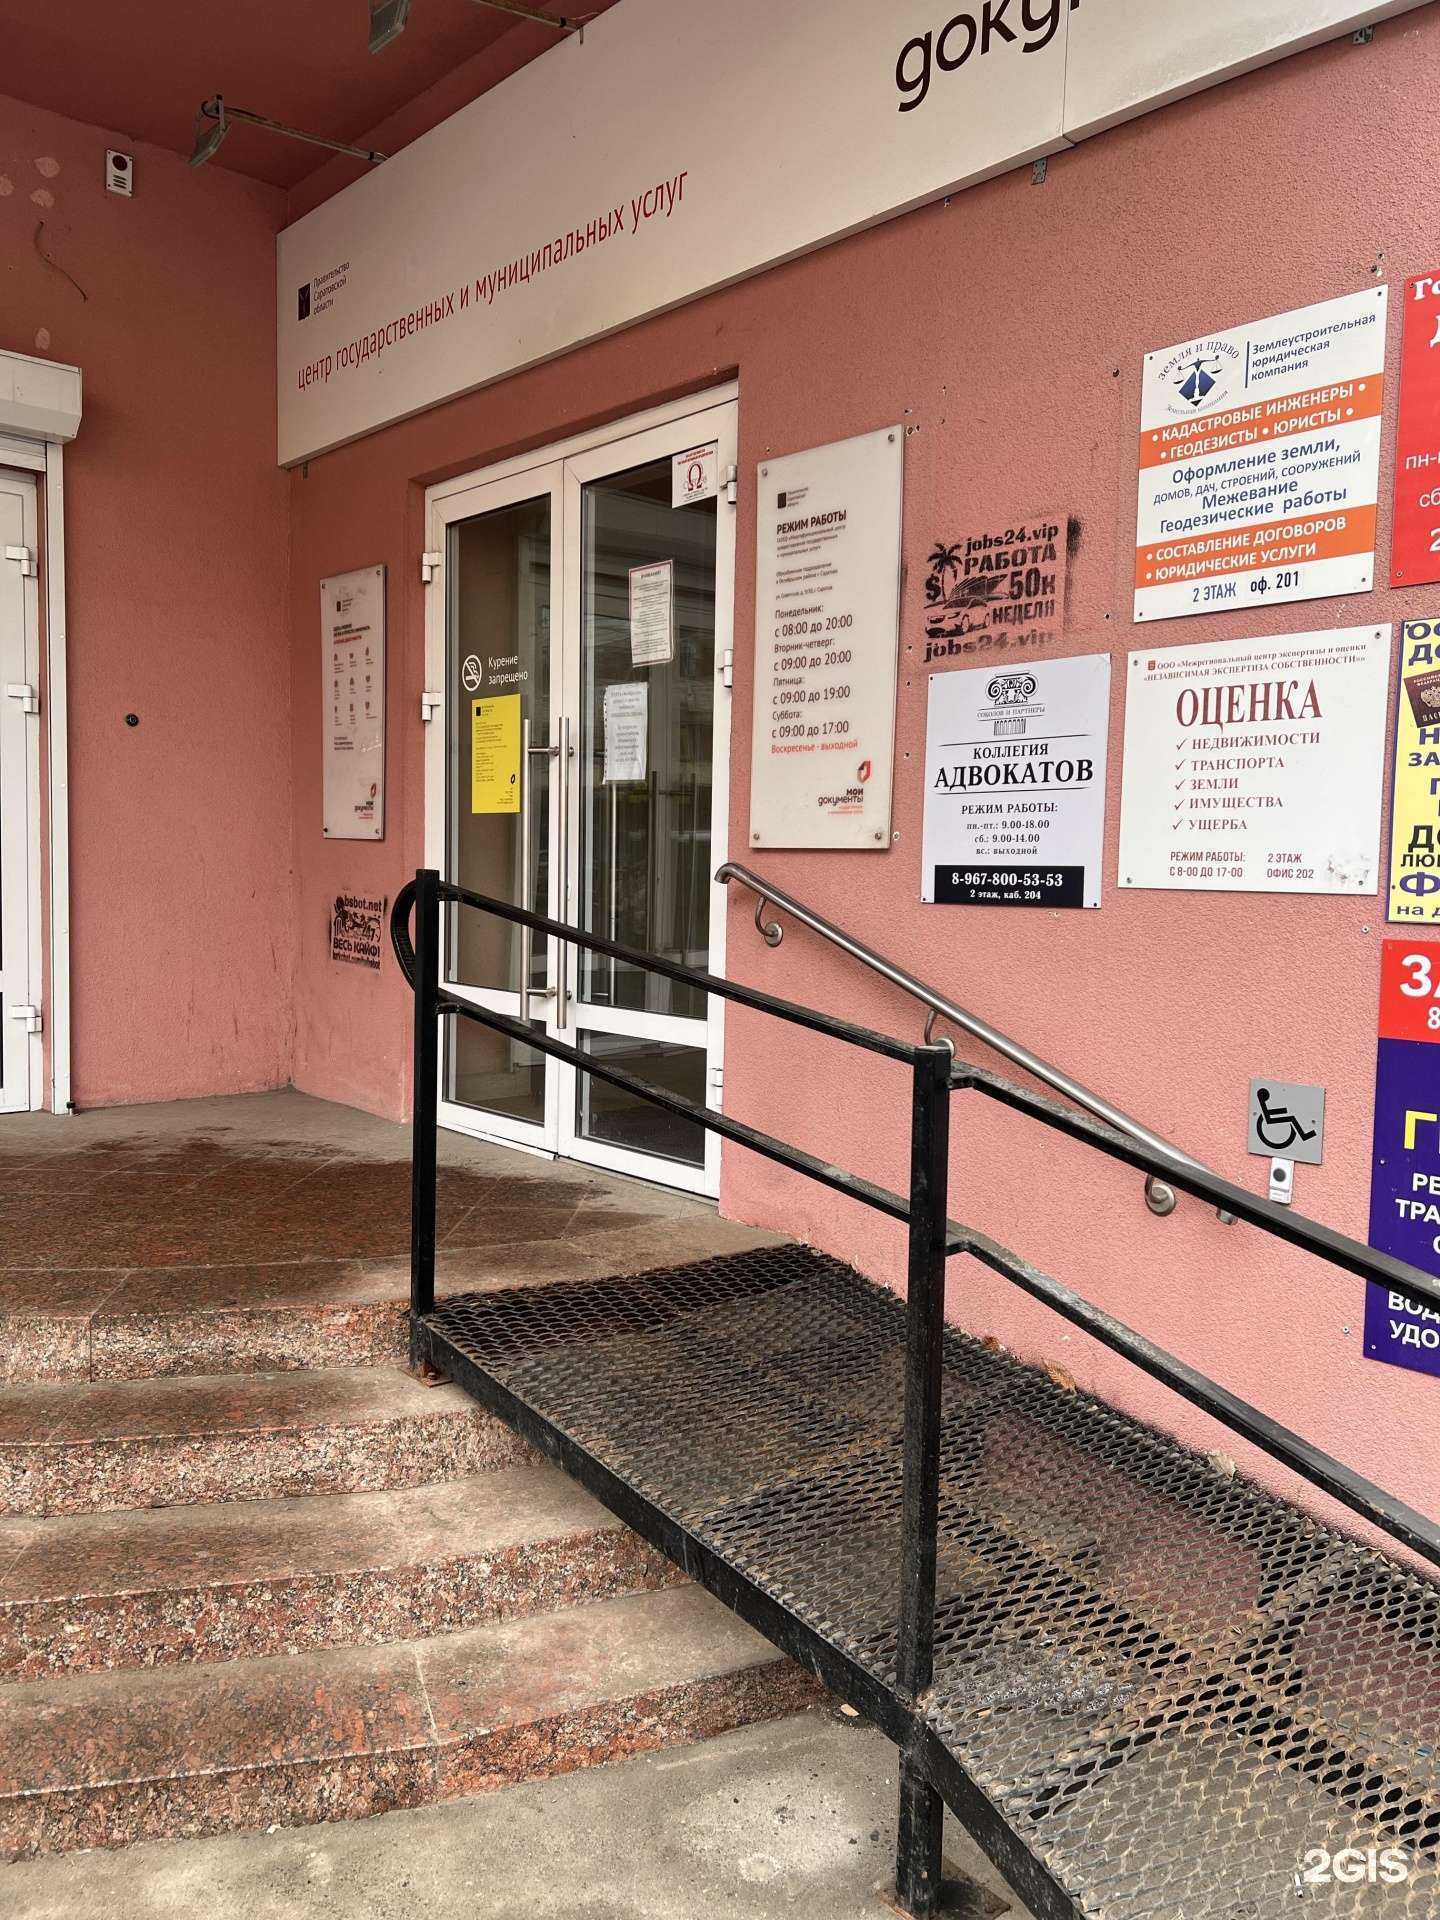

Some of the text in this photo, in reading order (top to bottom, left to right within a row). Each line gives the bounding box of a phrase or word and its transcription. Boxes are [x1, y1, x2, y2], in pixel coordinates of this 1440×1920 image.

[895, 0, 1080, 112] доку
[298, 171, 688, 391] центр государственных и муниципальных услуг
[1252, 313, 1376, 355] Землеустроительная
[1158, 341, 1240, 381] земля и право
[1251, 340, 1330, 369] юридическая
[1250, 359, 1309, 382] компания
[1162, 383, 1354, 442] КАДАСТРОВЫЕ ИНЖЕНЕРЫ
[1170, 408, 1341, 460] ГЕОДЕЗИСТЫ ЮРИСТЫ
[1172, 438, 1341, 485] Оформление земли,
[1405, 453, 1440, 470] пн-
[1153, 451, 1362, 506] ДОМОВ, ДАЧ, СТРОЕНИЙ, СООРУЖЕНИЙ
[1201, 480, 1299, 510] Межевание
[1160, 487, 1347, 534] Геодезические работы
[776, 518, 809, 535] РЕЖИМ
[810, 509, 847, 528] РАБОТЫ
[965, 523, 1059, 556] jobs24.vip
[1156, 516, 1346, 561] СОСТАВЛЕНИЕ ДОГОВОРОВ
[964, 543, 1057, 575] РАБОТА
[1155, 543, 1316, 581] ЮРИДИЧЕСКИЕ УСЛУГИ
[1192, 571, 1300, 602] 2 ЭТАЖ оф. 201
[775, 604, 824, 619] Понедельник:
[774, 614, 853, 637] с 08:00 до 20:00
[774, 638, 835, 653] Вторник-четверг:
[488, 654, 519, 669] Курение
[773, 650, 852, 671] с 09:00 до 20:00
[1157, 661, 1176, 670] ООО
[1253, 652, 1277, 662] центр
[1279, 648, 1326, 659] экспертизы
[1335, 643, 1366, 653] оценки
[488, 671, 528, 687] запрещено
[1211, 663, 1269, 676] ЭКСПЕРТИЗА
[773, 676, 805, 687] Пятница:
[772, 685, 851, 705] с 09:00 до 19:00
[1176, 678, 1323, 733] ОЦЕНКА
[772, 710, 802, 721] Суббота:
[771, 720, 849, 738] с 09:00 до 17:00
[771, 743, 816, 754] Воскресенье
[820, 740, 858, 751] выходной
[973, 743, 1049, 760] КОЛЛЕГИЯ
[1191, 732, 1321, 752] НЕДВИЖИМОСТИ
[1190, 756, 1285, 772] ТРАНСПОРТА
[934, 758, 1094, 792] АДВОКАТОВ
[1190, 778, 1239, 791] ЗЕМЛИ
[818, 795, 864, 806] документы
[961, 802, 1058, 815] РЕЖИМ РАБОТЫ:
[1189, 796, 1283, 810] ИМУЩЕСТВА
[966, 819, 1050, 831] пн.-пт.: 9.00-18.00
[1188, 818, 1248, 832] УЩЕРБА
[974, 833, 1040, 843] сб.: 9.00-14.00
[1408, 825, 1440, 853] Д
[993, 846, 1038, 856] выходной
[1170, 851, 1246, 863] РЕЖИМ РАБОТЫ:
[1267, 852, 1302, 864] 2 ЭТАЖ
[1401, 854, 1440, 867] ЛЮ
[951, 872, 1063, 887] 8-967-800-53-53
[1169, 866, 1243, 879] С 8-00 ДО 17-00
[1267, 867, 1314, 879] ОФИС 202
[970, 889, 1041, 900] 2 этаж, каб. 204
[1397, 905, 1424, 915] на
[1400, 954, 1440, 997] З
[1388, 1319, 1440, 1349] УДО
